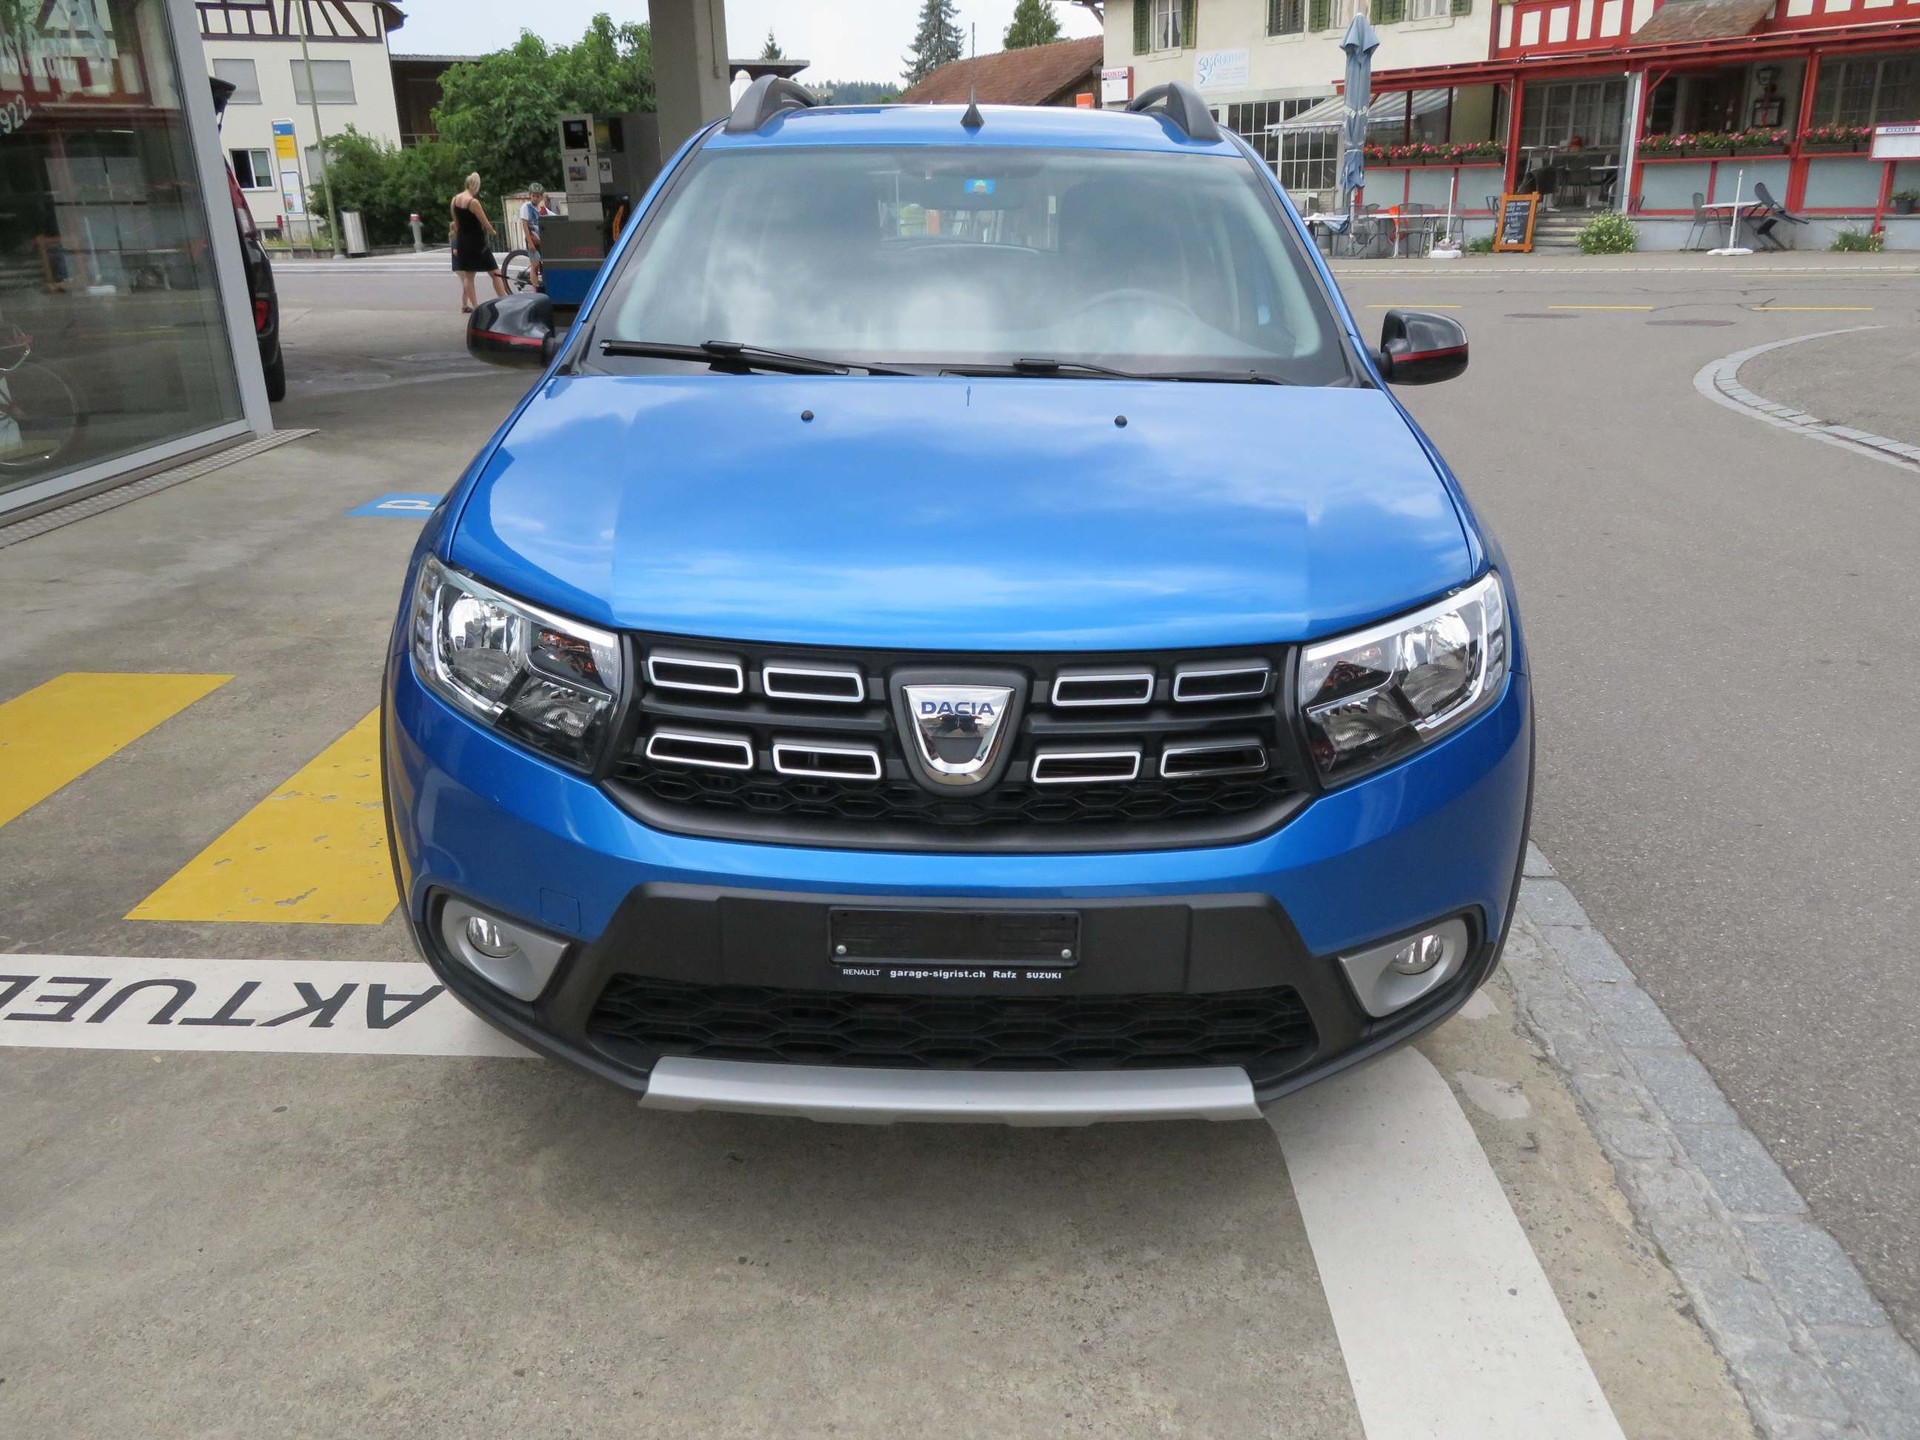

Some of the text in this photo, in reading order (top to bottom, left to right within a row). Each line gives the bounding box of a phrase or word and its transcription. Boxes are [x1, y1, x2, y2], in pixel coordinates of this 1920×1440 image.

[1102, 69, 1127, 78] HONDA
[583, 155, 590, 167] 1
[921, 701, 995, 716] DACIA
[842, 968, 1062, 979] RENAULT garage-sigrist.ch Rafz SUZUKI
